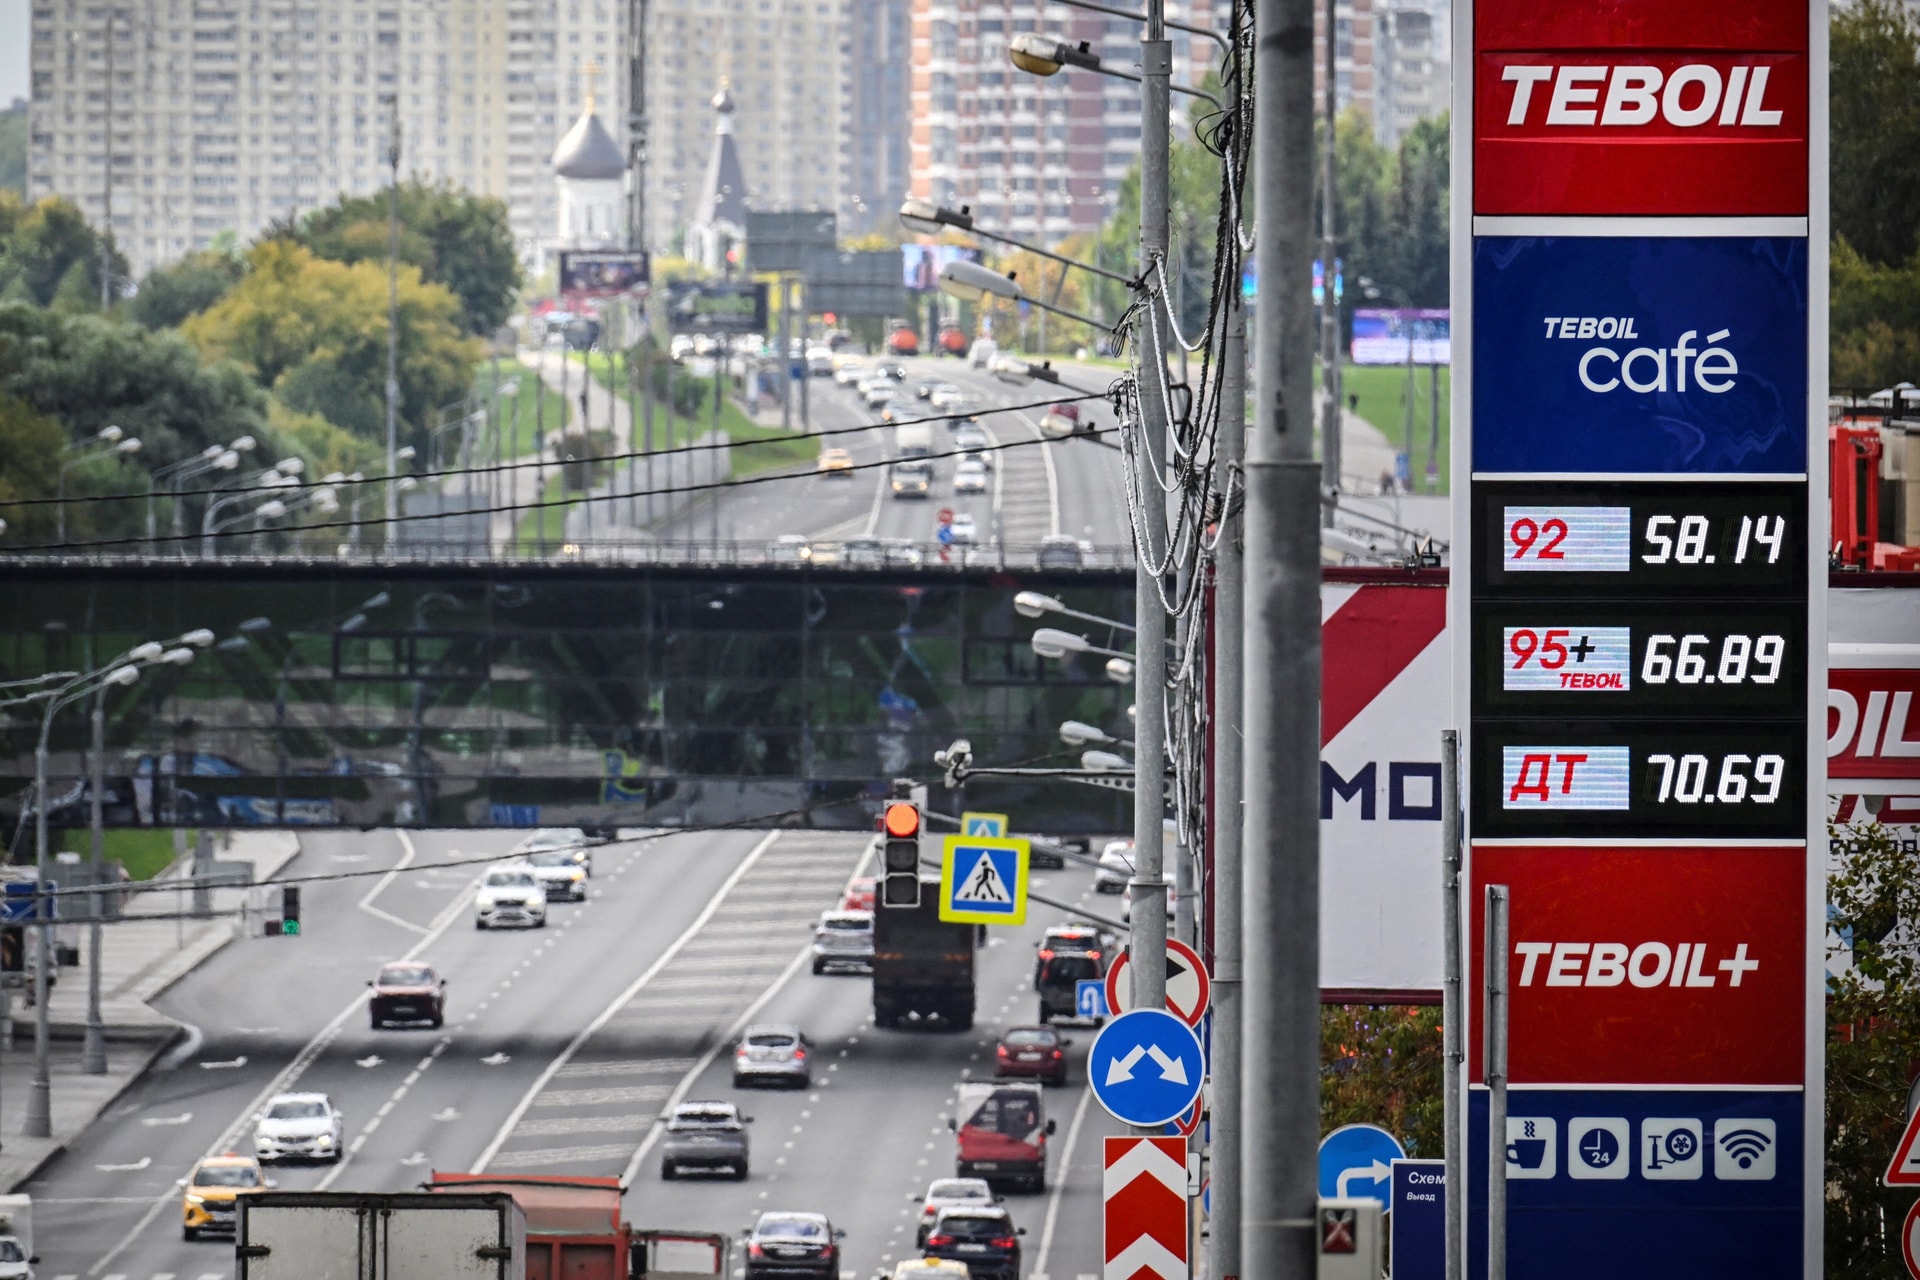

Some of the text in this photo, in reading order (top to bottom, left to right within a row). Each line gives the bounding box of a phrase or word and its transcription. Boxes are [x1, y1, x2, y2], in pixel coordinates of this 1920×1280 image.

[1501, 64, 1783, 127] TEBOIL
[1543, 317, 1638, 339] TEBOIL
[1578, 329, 1738, 393] café
[1510, 518, 1568, 560] 92
[1642, 515, 1785, 563] 58.14
[1510, 629, 1596, 669] 95+
[1642, 634, 1785, 684] 66.89
[1559, 673, 1624, 688] TEBOIL
[1509, 754, 1588, 801] ДТ
[1648, 755, 1785, 803] 70.69
[1515, 942, 1759, 988] TEBOIL+
[1592, 1152, 1610, 1164] 24
[1407, 1192, 1435, 1202] Выезд
